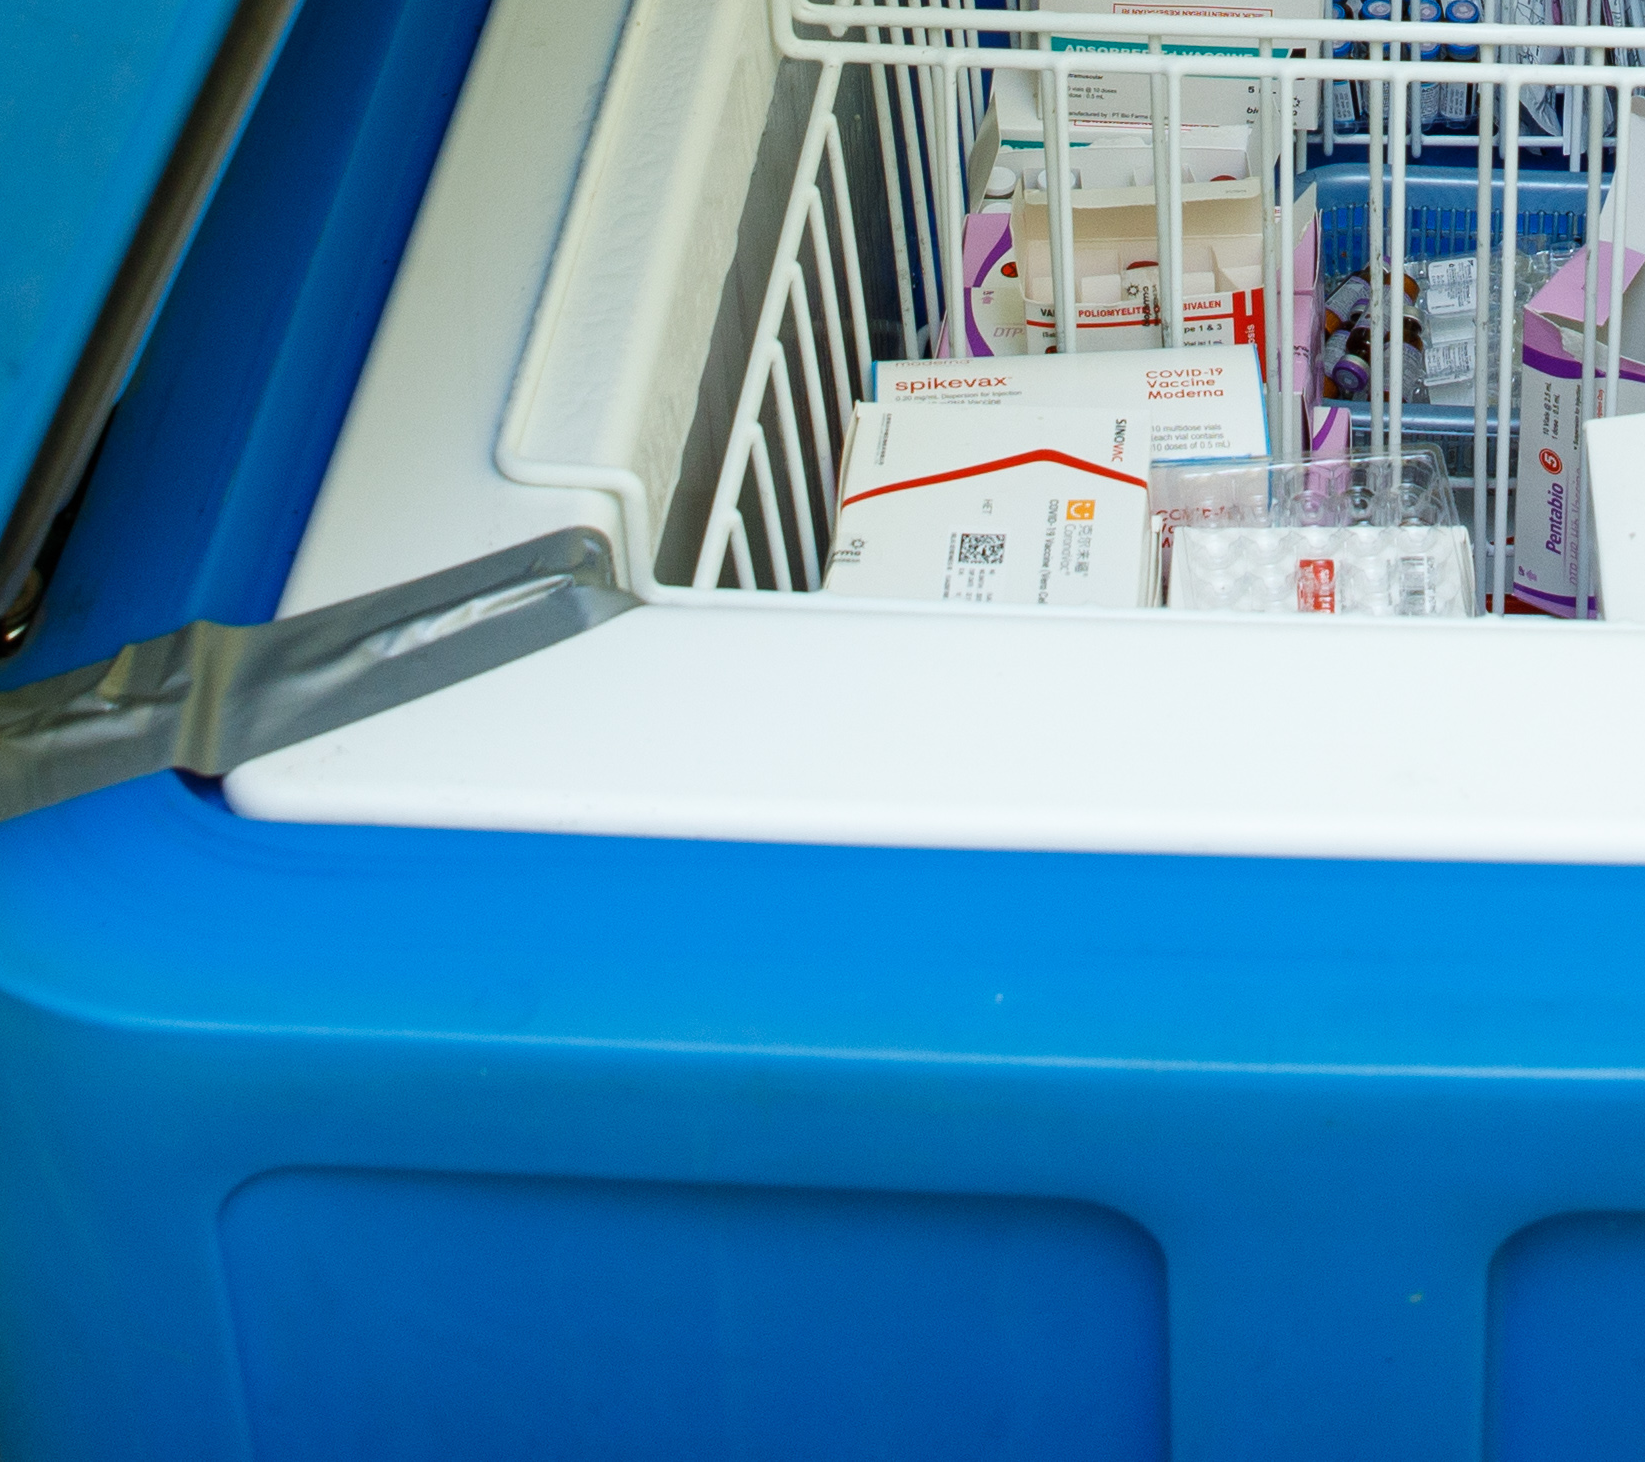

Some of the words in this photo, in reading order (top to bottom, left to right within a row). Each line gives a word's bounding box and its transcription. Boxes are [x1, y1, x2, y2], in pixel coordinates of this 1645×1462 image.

[1145, 367, 1224, 379] COVID-19
[894, 376, 1008, 394] spikevax
[1146, 377, 1216, 389] Vaccine
[1147, 388, 1224, 401] Moderna
[1110, 417, 1127, 463] SINOVAC
[1190, 432, 1225, 441] contains
[1544, 482, 1564, 556] Pentabio
[1042, 537, 1055, 568] Vaccine
